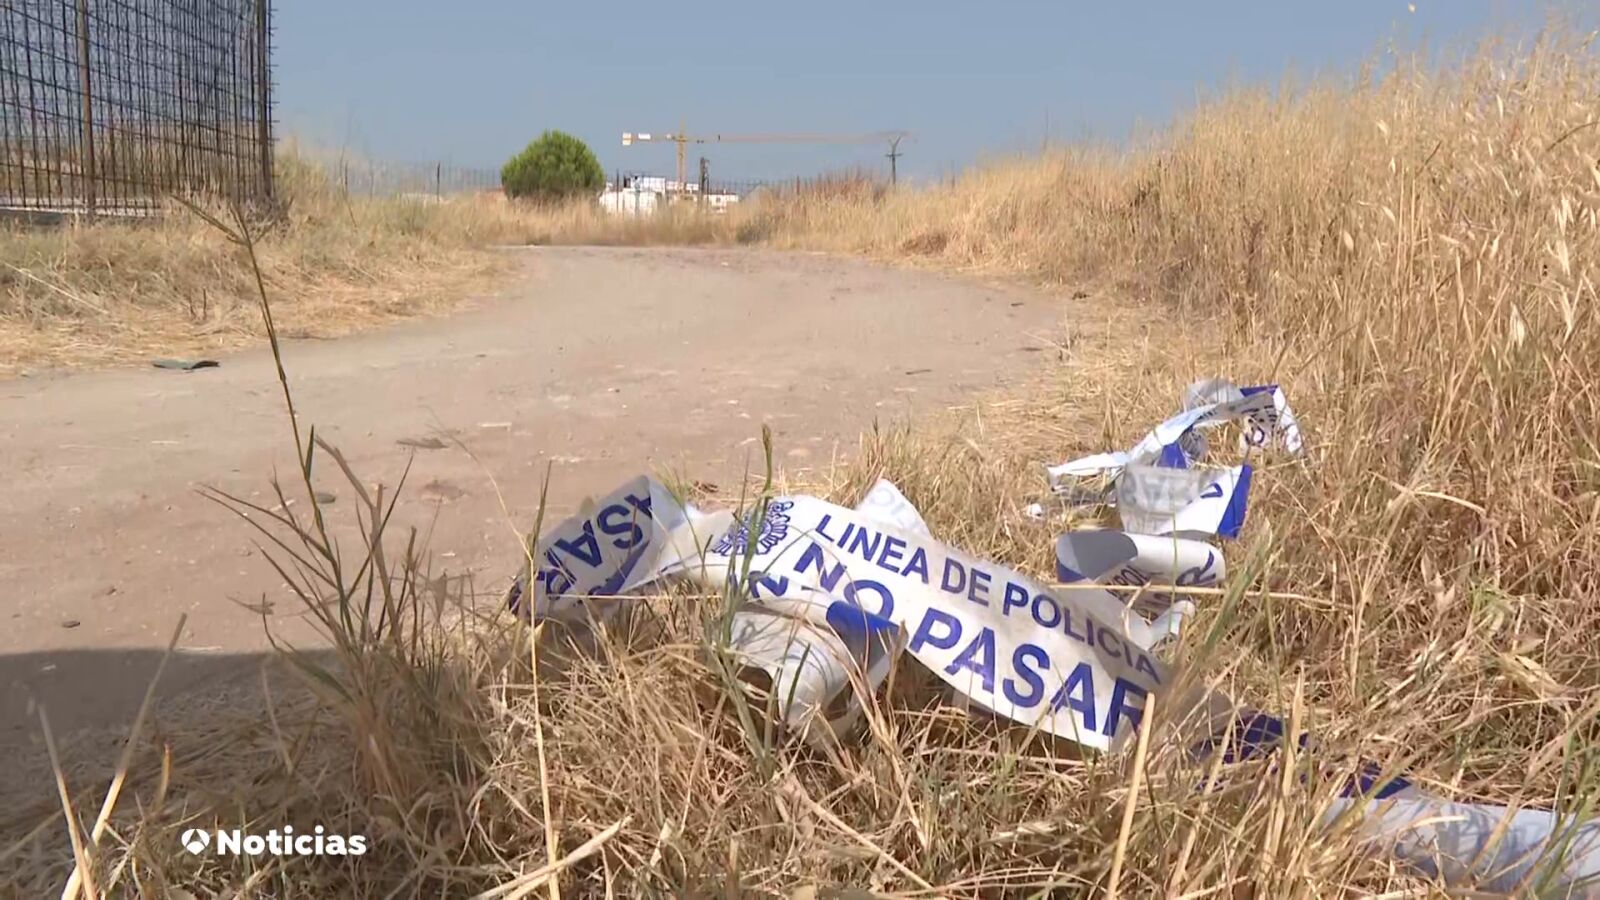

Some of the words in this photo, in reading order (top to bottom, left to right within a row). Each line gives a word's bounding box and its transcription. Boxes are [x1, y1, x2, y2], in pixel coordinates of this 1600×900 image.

[793, 541, 895, 622] NO
[908, 606, 1149, 739] PASAR
[814, 514, 930, 585] LINEA
[940, 557, 992, 607] DE
[1002, 581, 1161, 686] POLICIA
